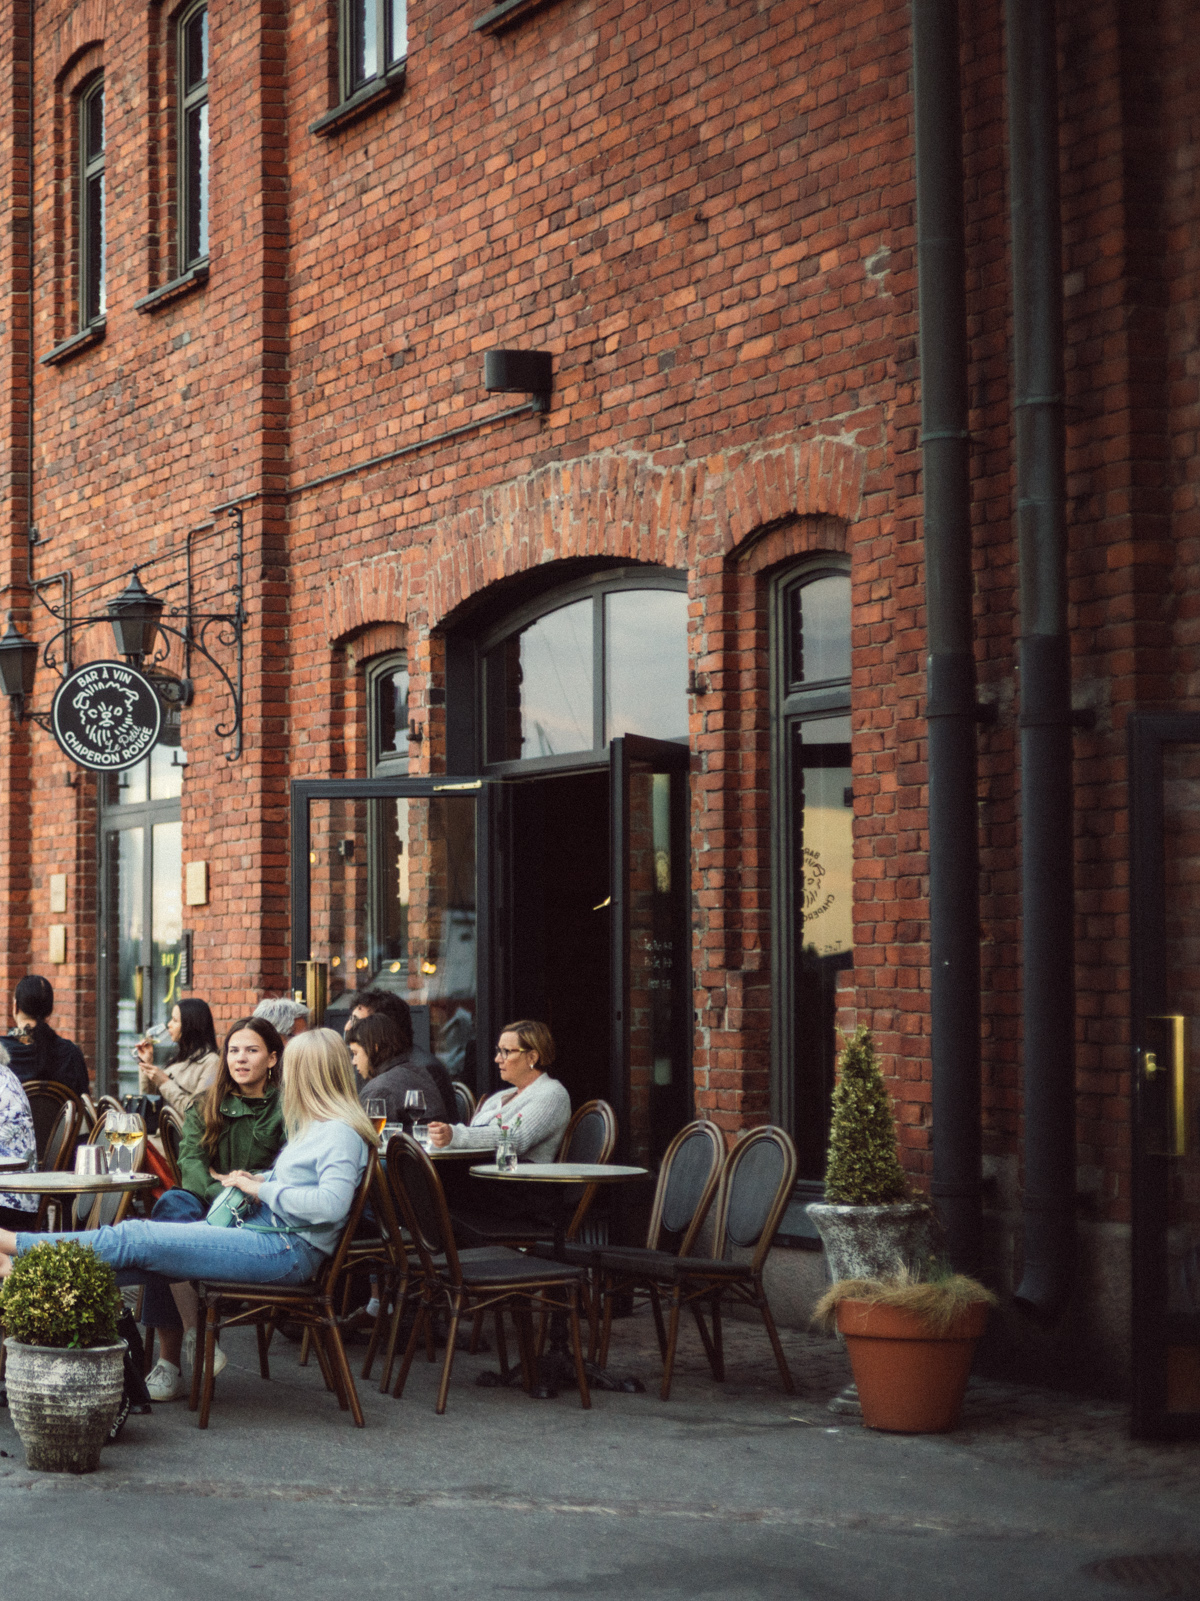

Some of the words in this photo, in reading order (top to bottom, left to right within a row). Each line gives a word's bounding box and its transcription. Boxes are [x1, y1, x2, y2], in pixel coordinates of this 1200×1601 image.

[76, 670, 99, 688] BAR
[102, 666, 109, 679] À
[113, 669, 132, 684] VIN
[64, 731, 120, 764] CHAPERON
[122, 726, 153, 760] ROUGE
[104, 739, 120, 753] Le
[118, 725, 141, 747] Petit
